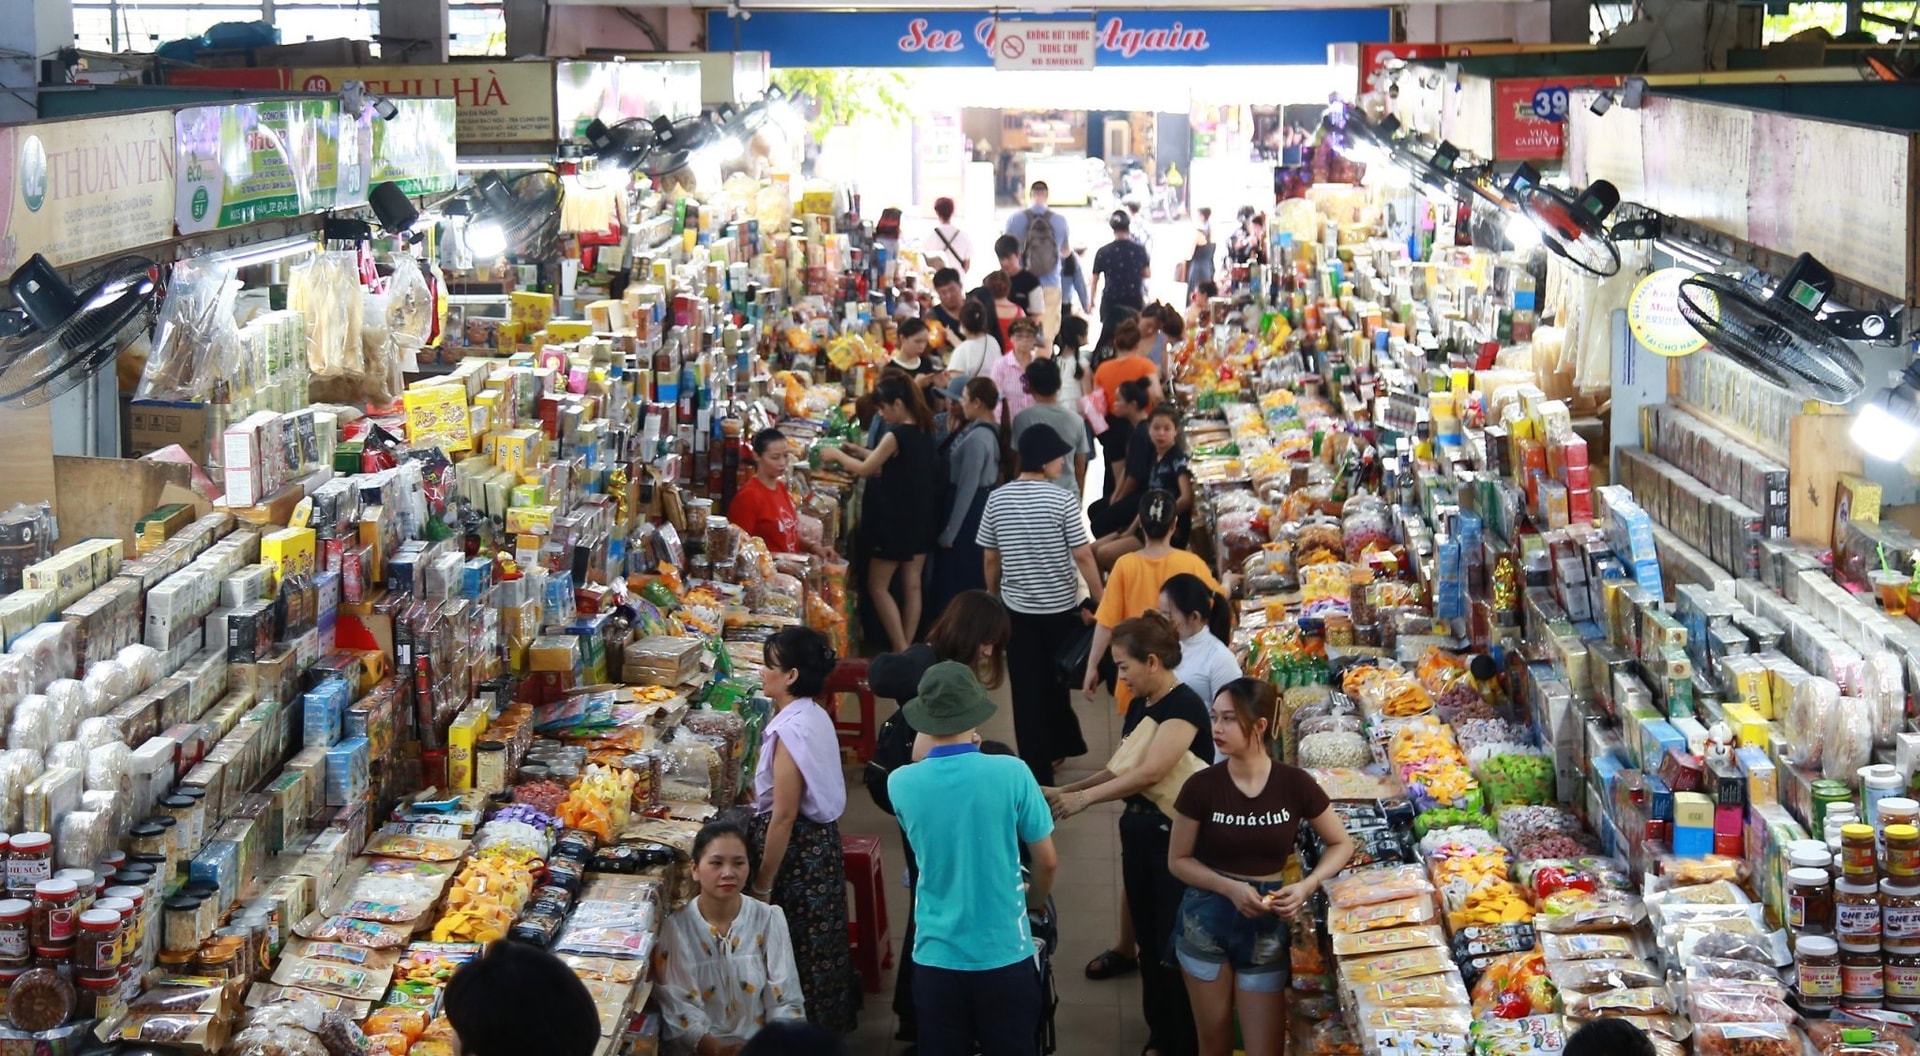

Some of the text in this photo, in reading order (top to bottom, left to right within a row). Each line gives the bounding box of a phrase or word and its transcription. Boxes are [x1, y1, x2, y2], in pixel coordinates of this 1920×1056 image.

[899, 17, 964, 51] See
[1097, 17, 1210, 58] Again
[1039, 43, 1059, 53] TRONG
[308, 79, 326, 92] 49
[451, 69, 509, 106] HÀ
[1535, 90, 1567, 117] 39
[186, 165, 202, 183] eco
[348, 165, 361, 193] 50
[194, 204, 204, 216] 51
[1212, 807, 1290, 826] monáclub
